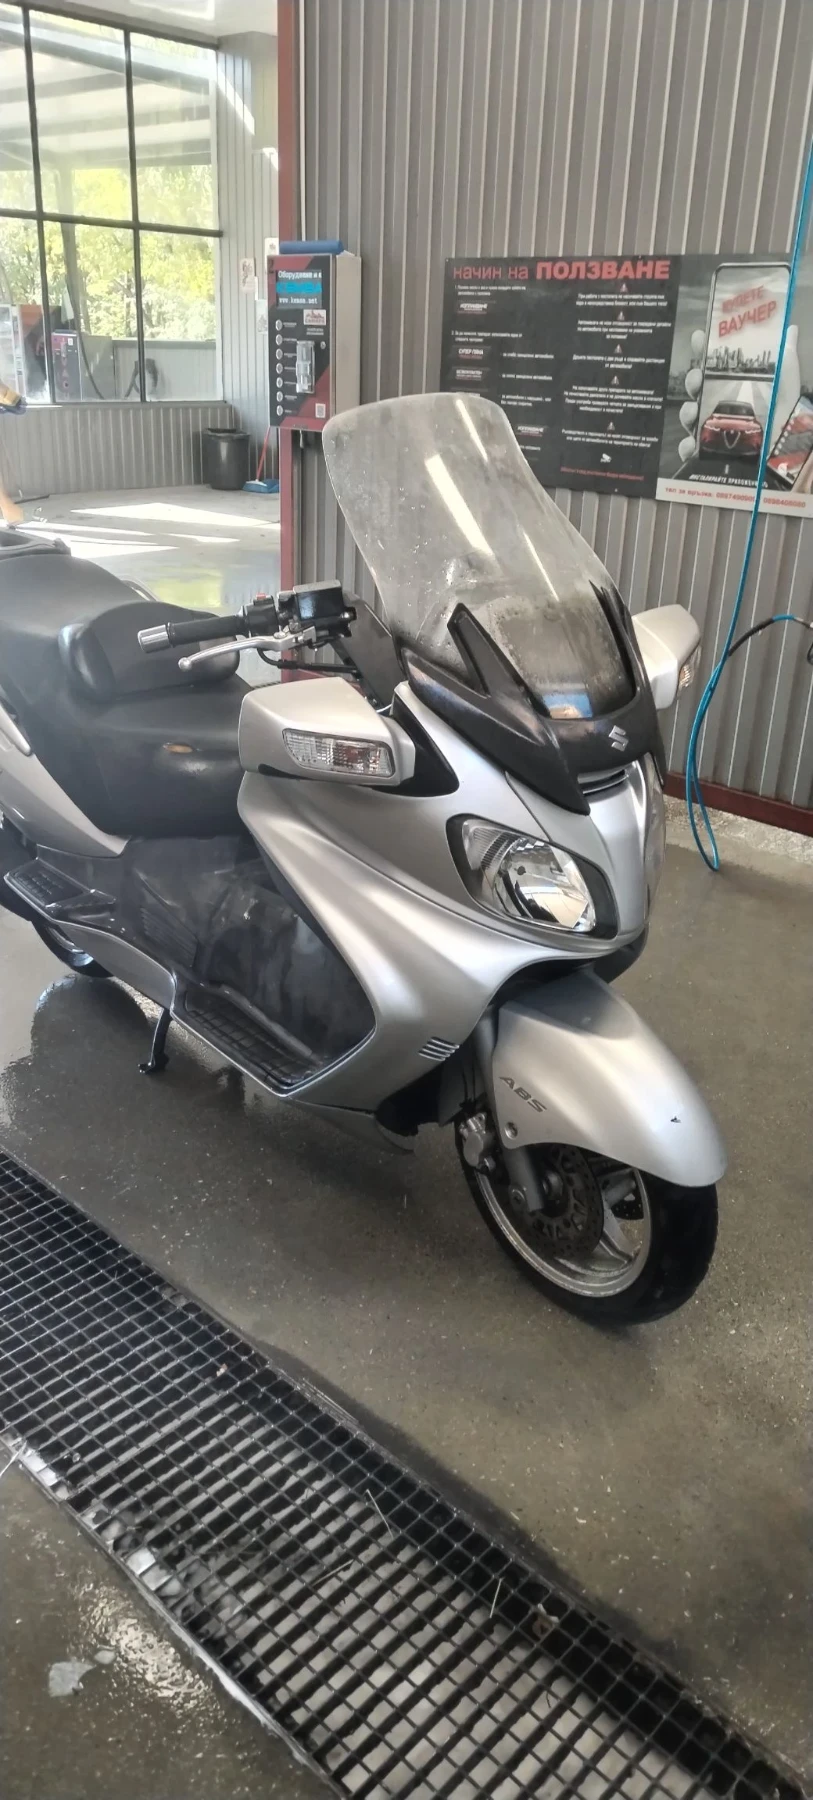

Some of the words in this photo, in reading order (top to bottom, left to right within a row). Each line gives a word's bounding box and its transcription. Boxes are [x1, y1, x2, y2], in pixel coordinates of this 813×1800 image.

[453, 266, 502, 280] начин
[508, 266, 529, 280] на
[536, 261, 670, 280] ПОЛЗВАНЕ
[718, 301, 777, 338] ВАУЧЕР
[499, 1076, 547, 1113] ABS
